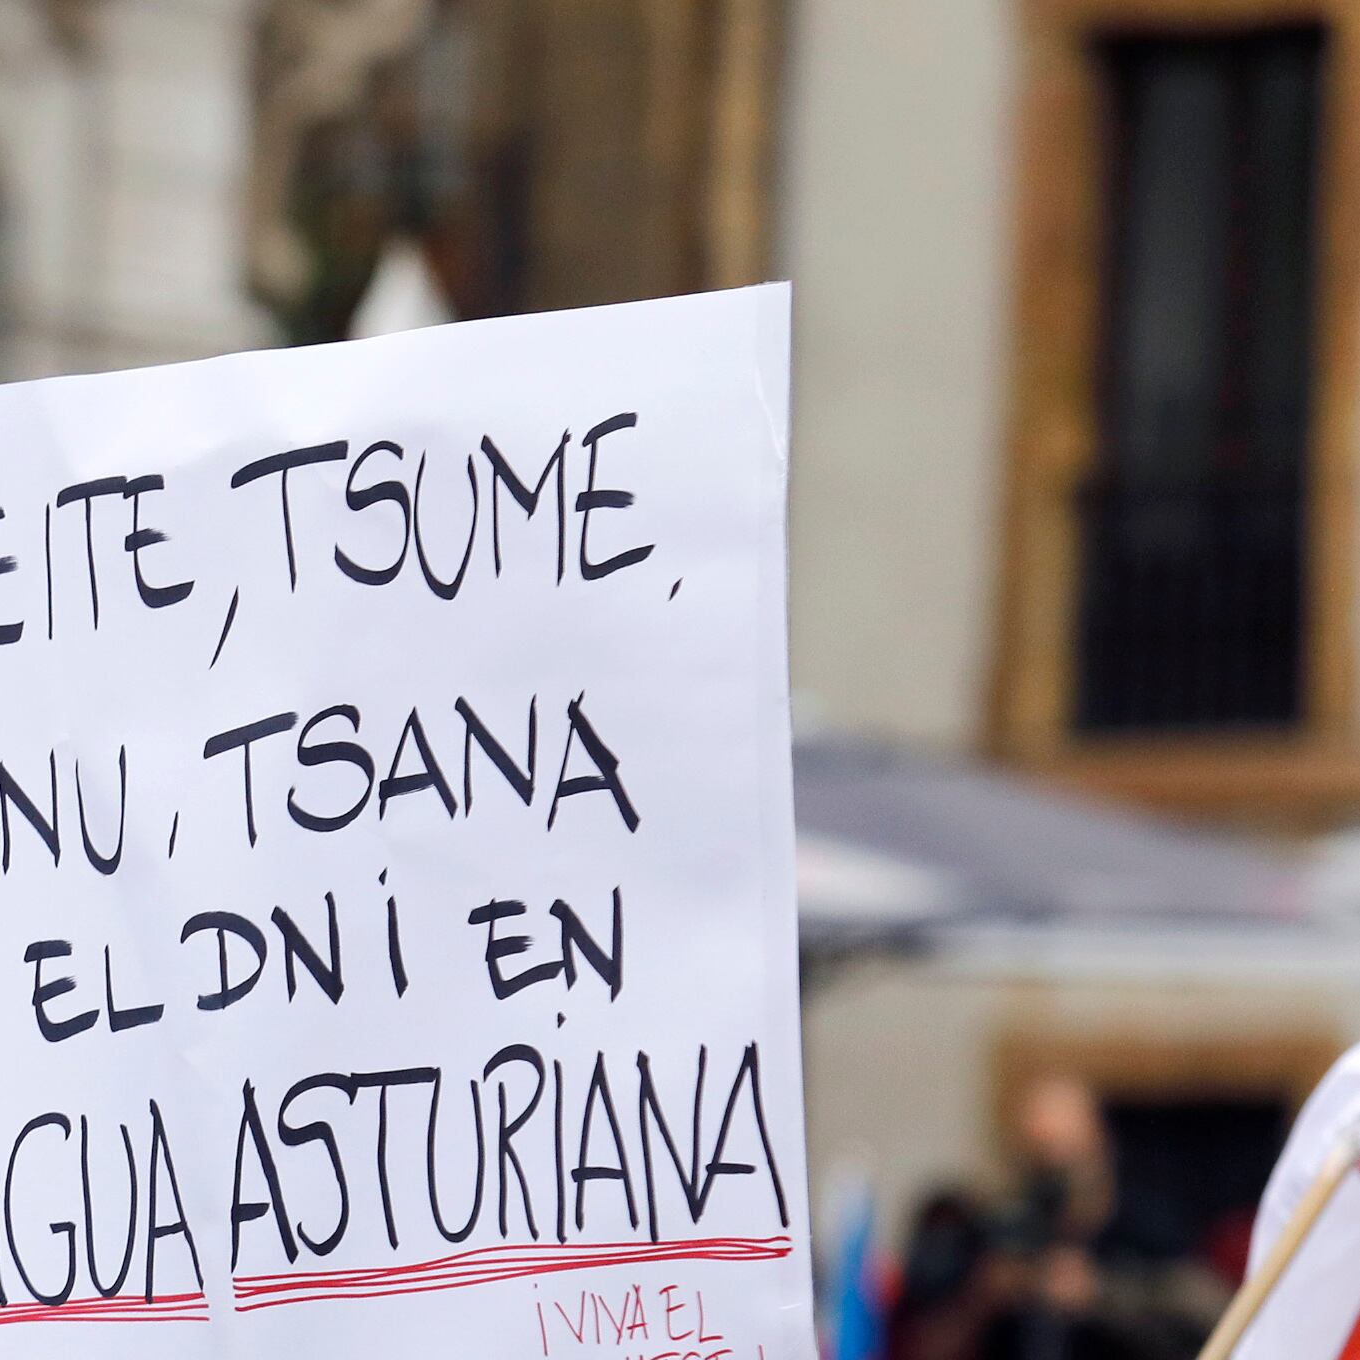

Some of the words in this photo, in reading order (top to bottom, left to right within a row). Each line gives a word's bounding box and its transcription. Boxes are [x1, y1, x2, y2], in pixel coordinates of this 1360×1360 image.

[203, 690, 640, 849] TSANA
[23, 939, 165, 1043] EL
[180, 868, 409, 1011] DNI
[467, 886, 623, 1003] EN
[230, 1012, 789, 1274] ASTURIANA
[658, 1284, 724, 1344] EL
